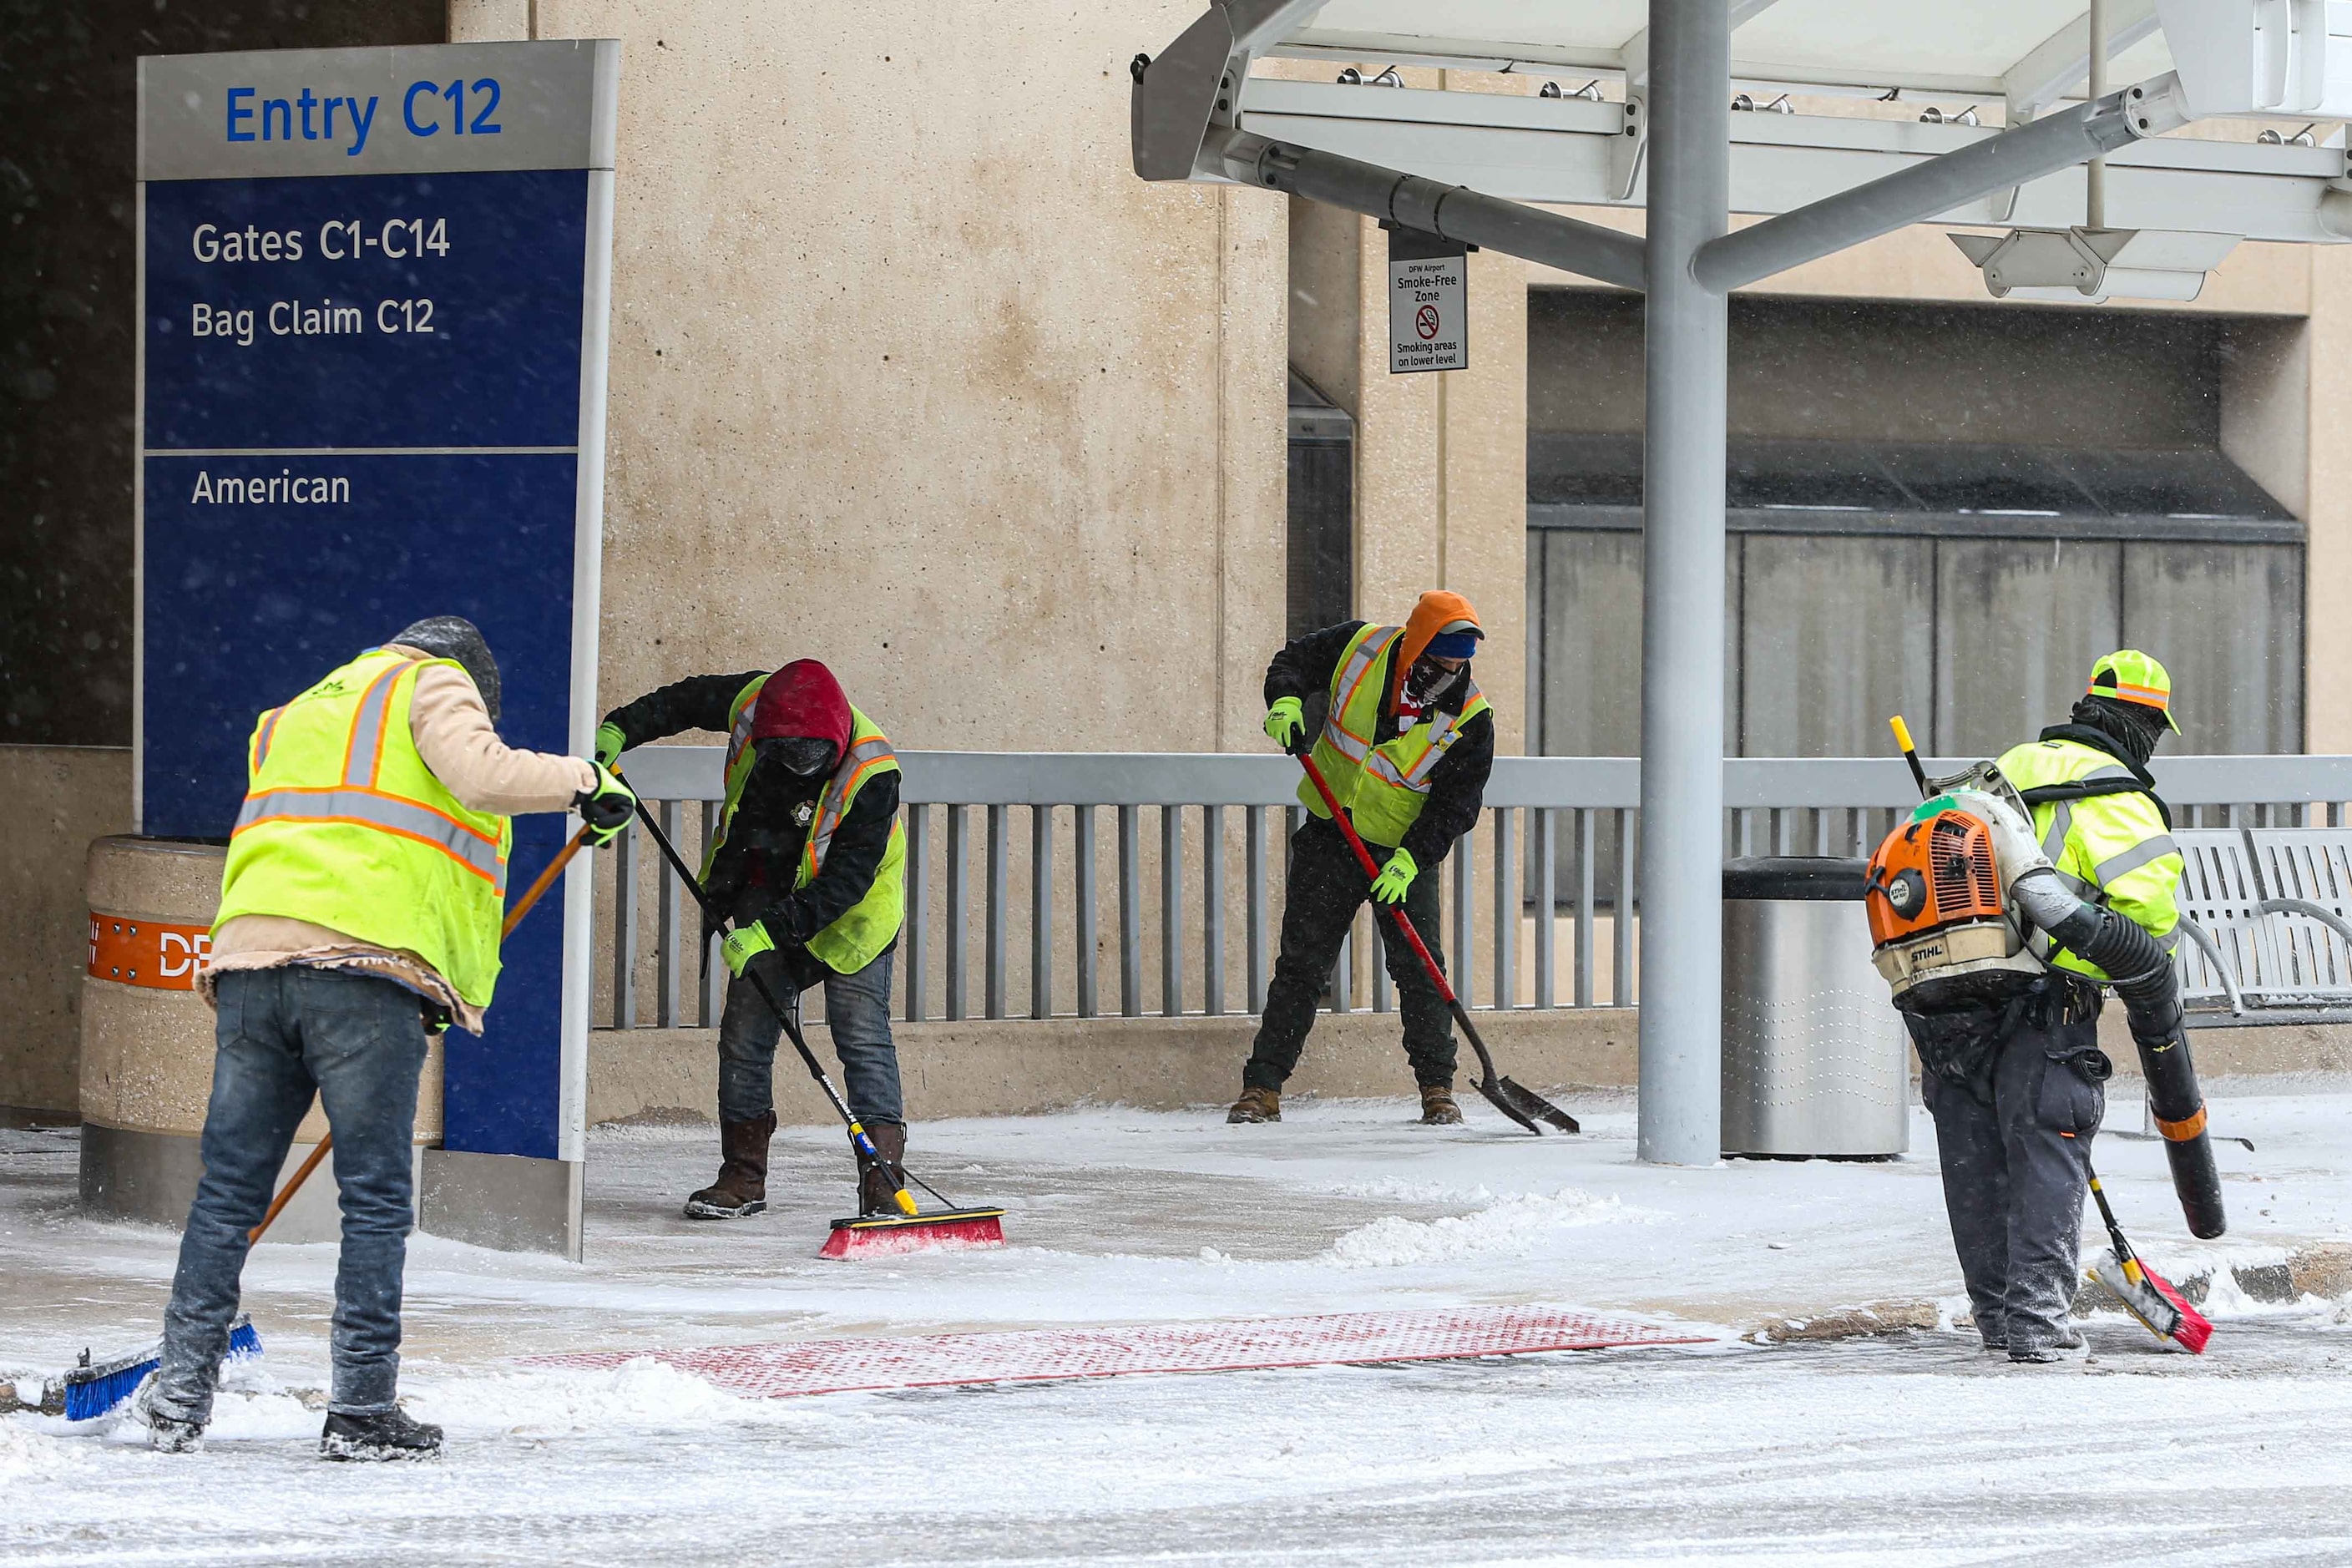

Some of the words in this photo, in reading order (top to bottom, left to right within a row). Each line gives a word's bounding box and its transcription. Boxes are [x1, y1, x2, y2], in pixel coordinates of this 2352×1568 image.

[227, 87, 378, 156] Entry
[403, 78, 502, 137] C12
[192, 223, 303, 262] Gates
[320, 218, 450, 260] C1-C14
[1409, 265, 1423, 273] DFW
[1424, 264, 1445, 274] Airport
[1398, 275, 1457, 290] Smoke-Free
[1414, 291, 1440, 302] Zone
[192, 303, 254, 346] Bag
[268, 298, 362, 335] Claim
[377, 298, 434, 333] C12
[1397, 341, 1433, 354] Smoking
[1434, 341, 1457, 351] areas
[1399, 358, 1409, 367] on
[1410, 356, 1434, 366] lower
[1436, 353, 1457, 364] level
[191, 468, 350, 503] American
[1911, 945, 1943, 963] STIHL
